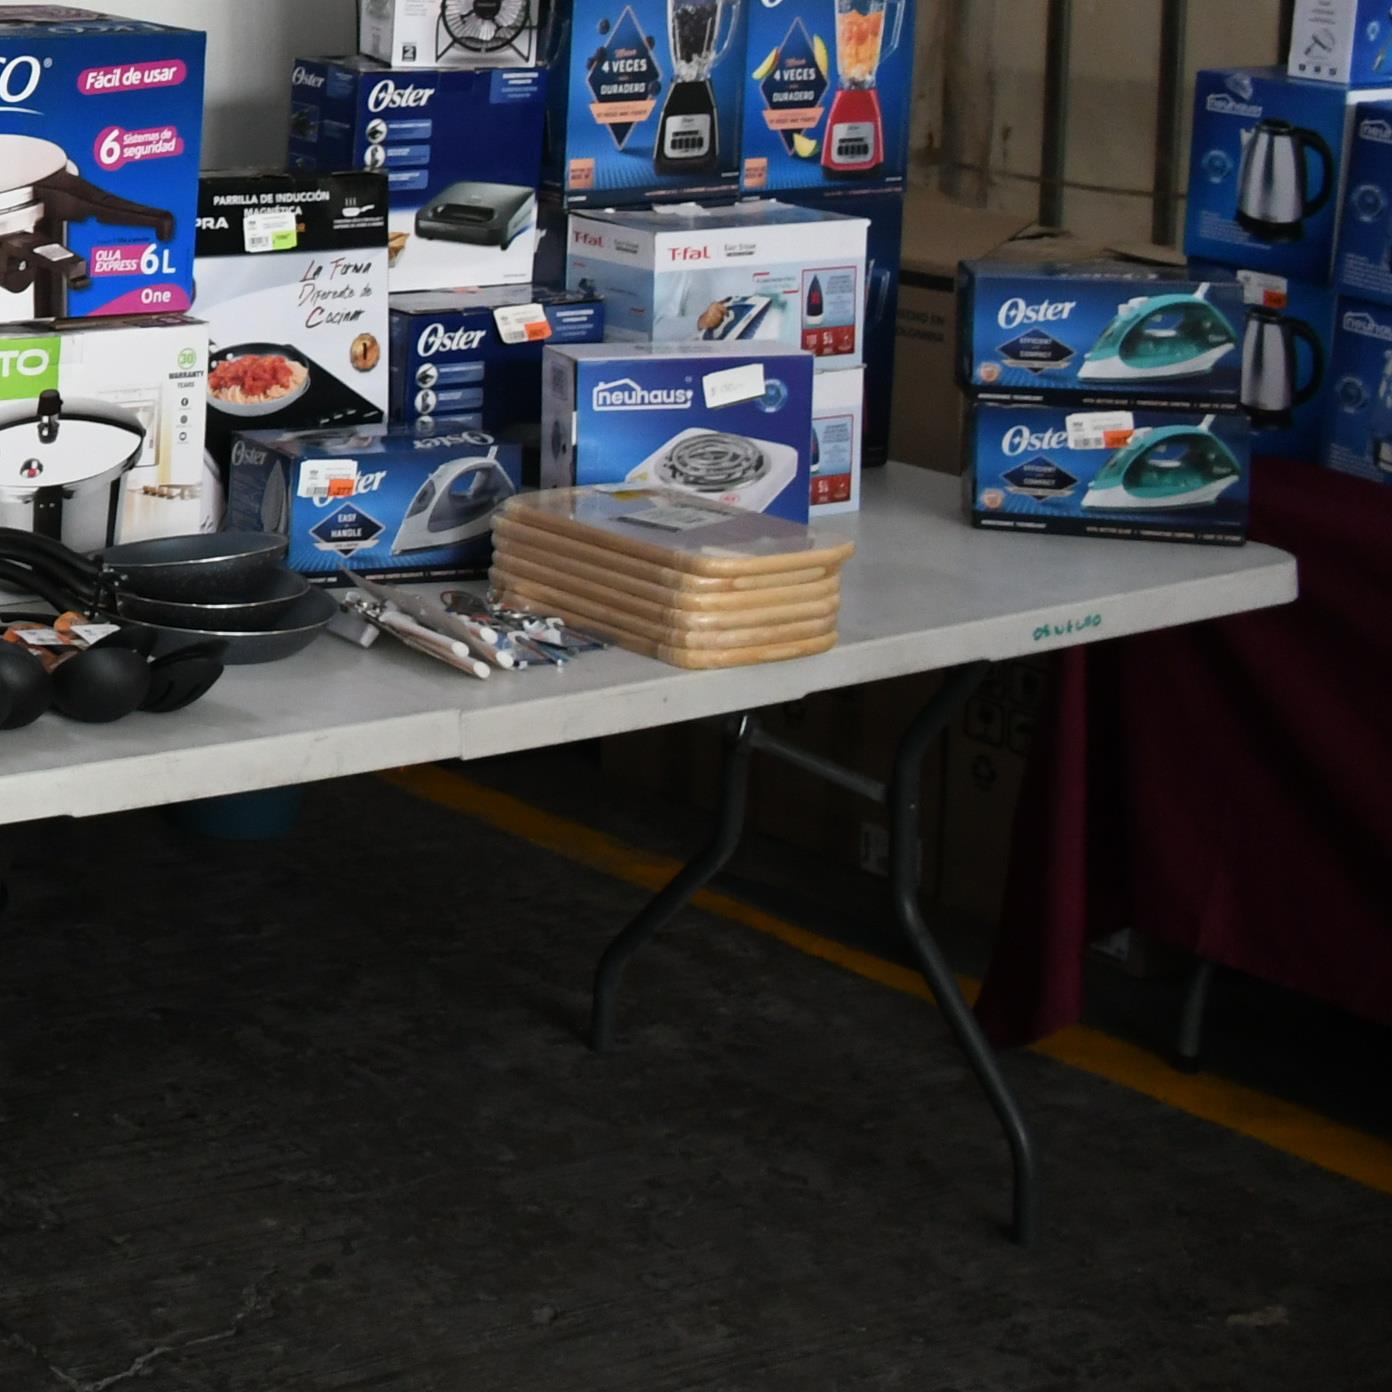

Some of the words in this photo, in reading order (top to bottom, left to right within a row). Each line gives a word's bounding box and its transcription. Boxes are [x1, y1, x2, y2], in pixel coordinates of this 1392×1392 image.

[291, 65, 325, 89] Oster
[601, 62, 610, 73] 4
[612, 59, 647, 73] VECES
[773, 70, 782, 81] 4
[783, 68, 816, 81] VECES
[85, 67, 121, 90] Fácil
[122, 67, 142, 85] de
[143, 67, 177, 83] usar
[367, 79, 435, 113] Oster
[100, 128, 121, 165] 6
[160, 128, 173, 139] de
[123, 137, 176, 159] seguridad
[213, 194, 258, 206] PARRILLA
[260, 193, 273, 204] DE
[276, 189, 330, 203] INDUCCIÓN
[195, 216, 229, 230] PRA
[95, 249, 122, 261] OLLA
[95, 259, 139, 273] EXPRESS
[140, 242, 159, 275] 6
[162, 249, 176, 274] L
[299, 260, 320, 282] La
[141, 288, 172, 304] One
[998, 297, 1076, 330] Oster
[418, 322, 486, 359] Oster
[169, 370, 204, 380] WARRANTY
[598, 390, 687, 405] neuhaus
[1002, 424, 1069, 457] Oste
[231, 440, 269, 466] Oster
[331, 527, 362, 538] HANDLE
